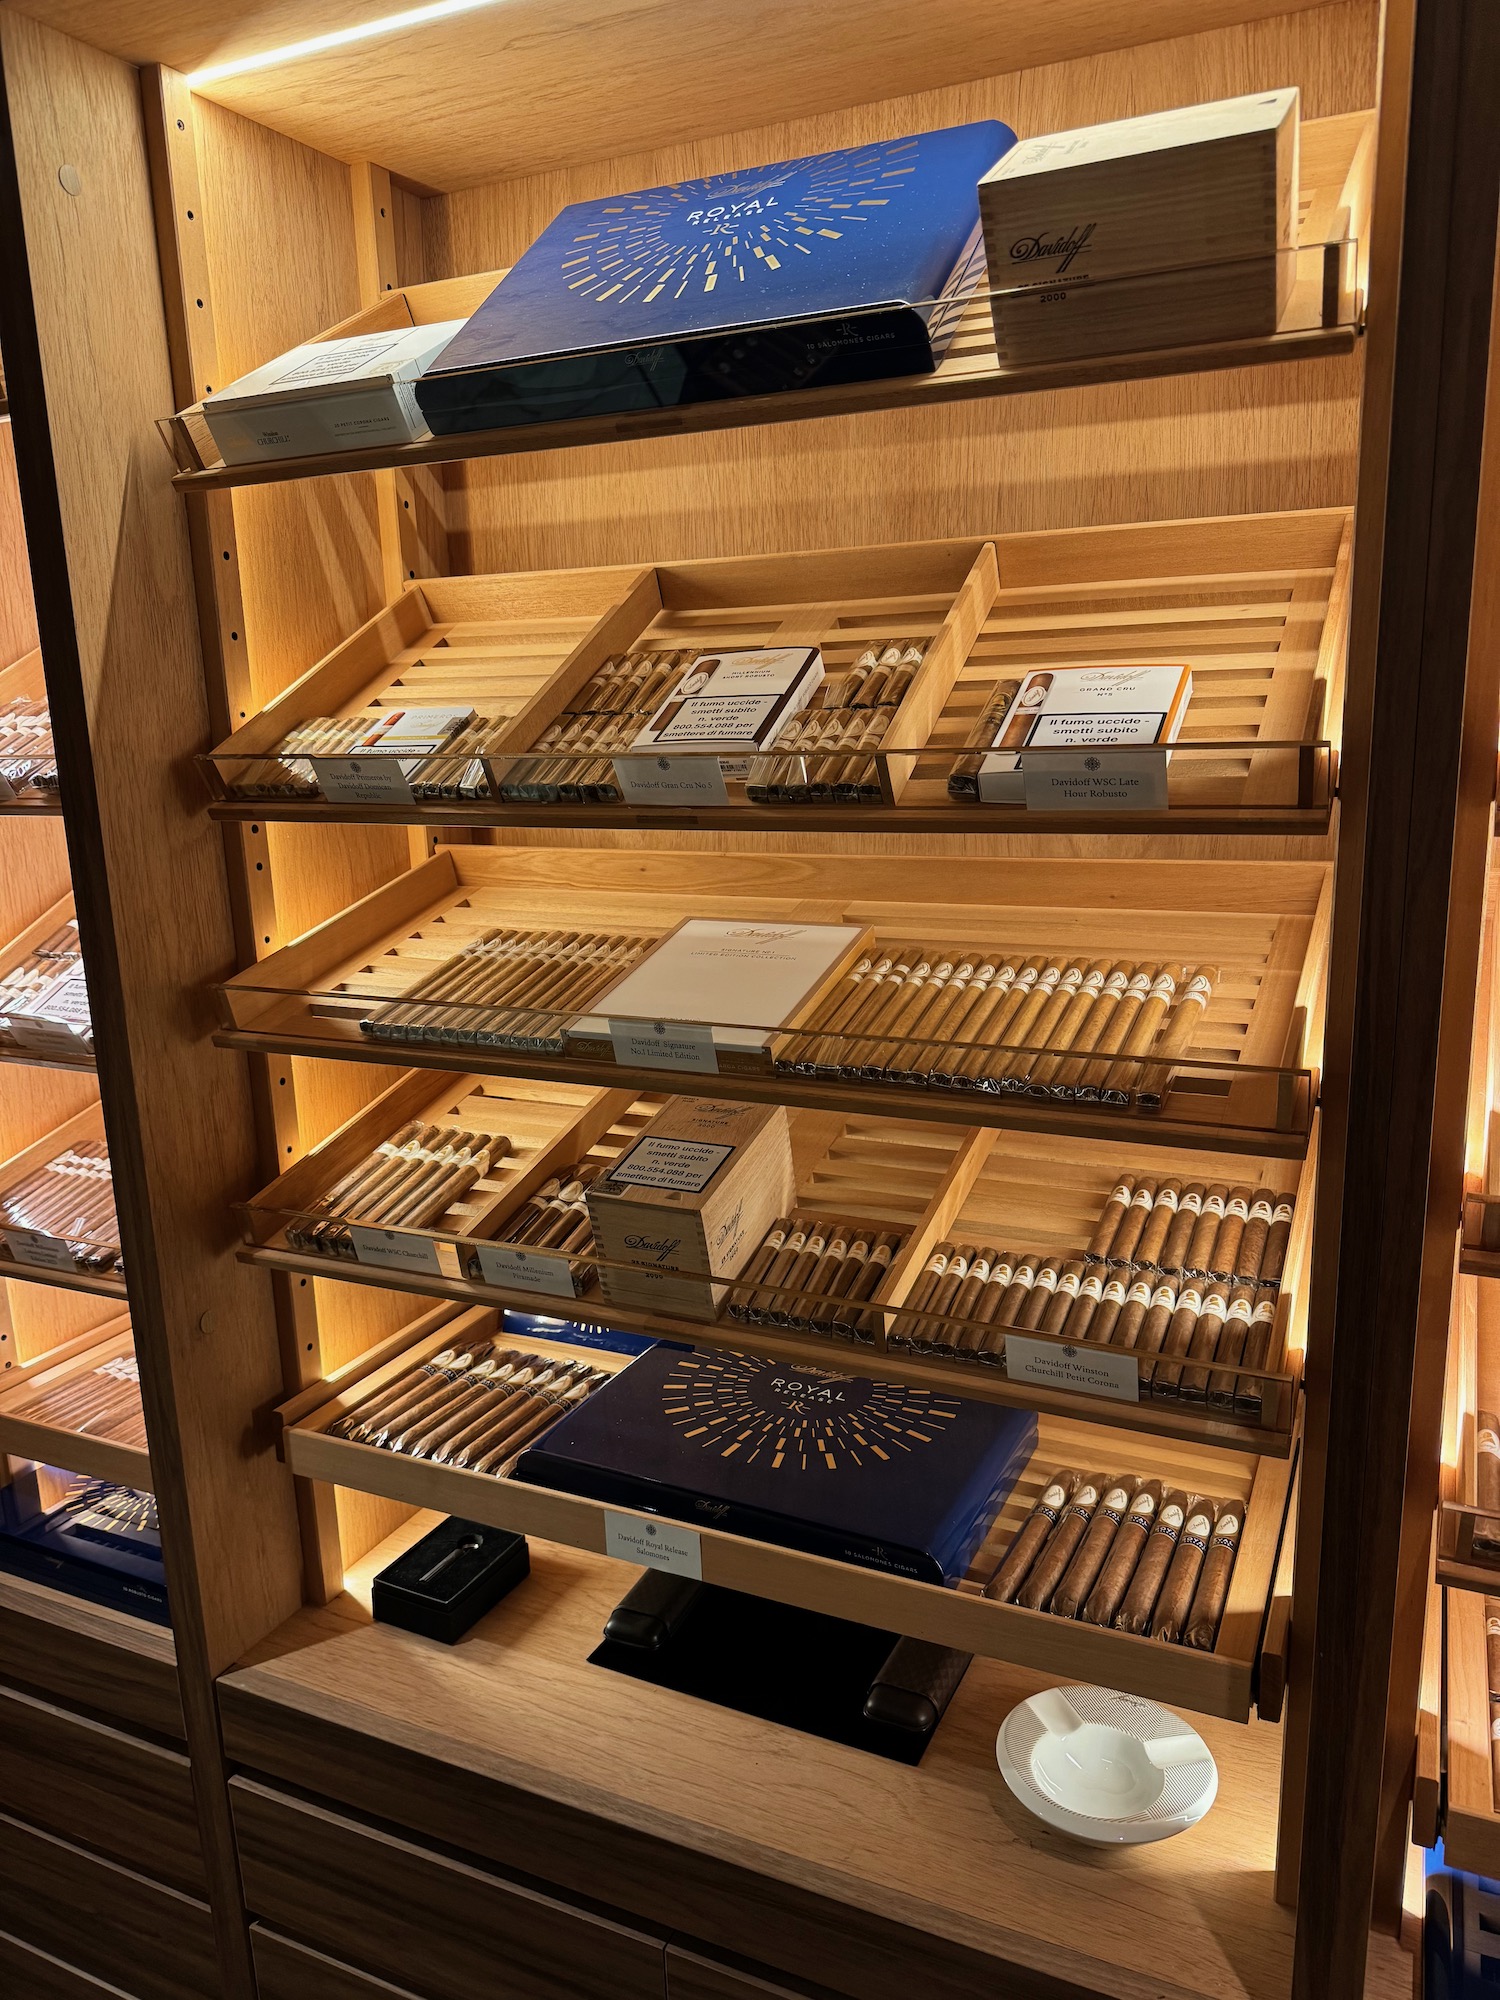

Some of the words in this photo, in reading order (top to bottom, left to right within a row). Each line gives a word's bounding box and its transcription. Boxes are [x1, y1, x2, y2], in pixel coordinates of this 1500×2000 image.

[686, 196, 779, 222] ROYAL
[1010, 223, 1097, 274] Davidoff
[1040, 292, 1066, 303] 2000
[817, 336, 865, 349] SALOMONES
[866, 332, 896, 342] CIGARS
[673, 722, 734, 730] 800.554.088
[383, 774, 392, 782] by
[1051, 777, 1090, 786] Davidoff
[1092, 777, 1117, 786] WSC
[1119, 778, 1139, 786] Late
[338, 782, 363, 790] Davidoff
[631, 781, 660, 789] Davidoff
[660, 781, 679, 789] Gran
[680, 781, 694, 789] Cru
[355, 791, 381, 800] Republic
[1064, 789, 1087, 798] Hour
[1090, 789, 1128, 798] Robusto
[631, 1038, 661, 1047] Davidoff
[663, 1040, 696, 1051] Signature
[647, 1048, 673, 1058] Limited
[675, 1050, 700, 1060] Edition
[647, 1150, 677, 1158] smetti
[678, 1153, 709, 1162] subito
[682, 1146, 714, 1154] uccide
[664, 1160, 691, 1168] verde
[627, 1163, 684, 1176] 800.554.088
[685, 1171, 704, 1179] per
[616, 1171, 656, 1182] smettere
[667, 1176, 700, 1187] fumare
[363, 1244, 387, 1253] Davidoff
[624, 1234, 681, 1261] Davidoff
[496, 1261, 522, 1272] Davidoff
[1034, 1356, 1071, 1370] Davidoff
[1072, 1364, 1109, 1378] Winston
[1025, 1364, 1064, 1378] Churchill
[1066, 1372, 1085, 1382] Petit
[1087, 1376, 1119, 1389] Corona
[771, 1377, 845, 1401] ROYAL
[774, 1388, 833, 1404] RELEASE
[618, 1532, 645, 1546] Davidoff
[645, 1539, 664, 1551] Royal
[664, 1544, 689, 1557] Release
[636, 1546, 670, 1561] Salomones
[853, 1552, 892, 1567] SALOMONES
[893, 1563, 918, 1574] CIGARS
